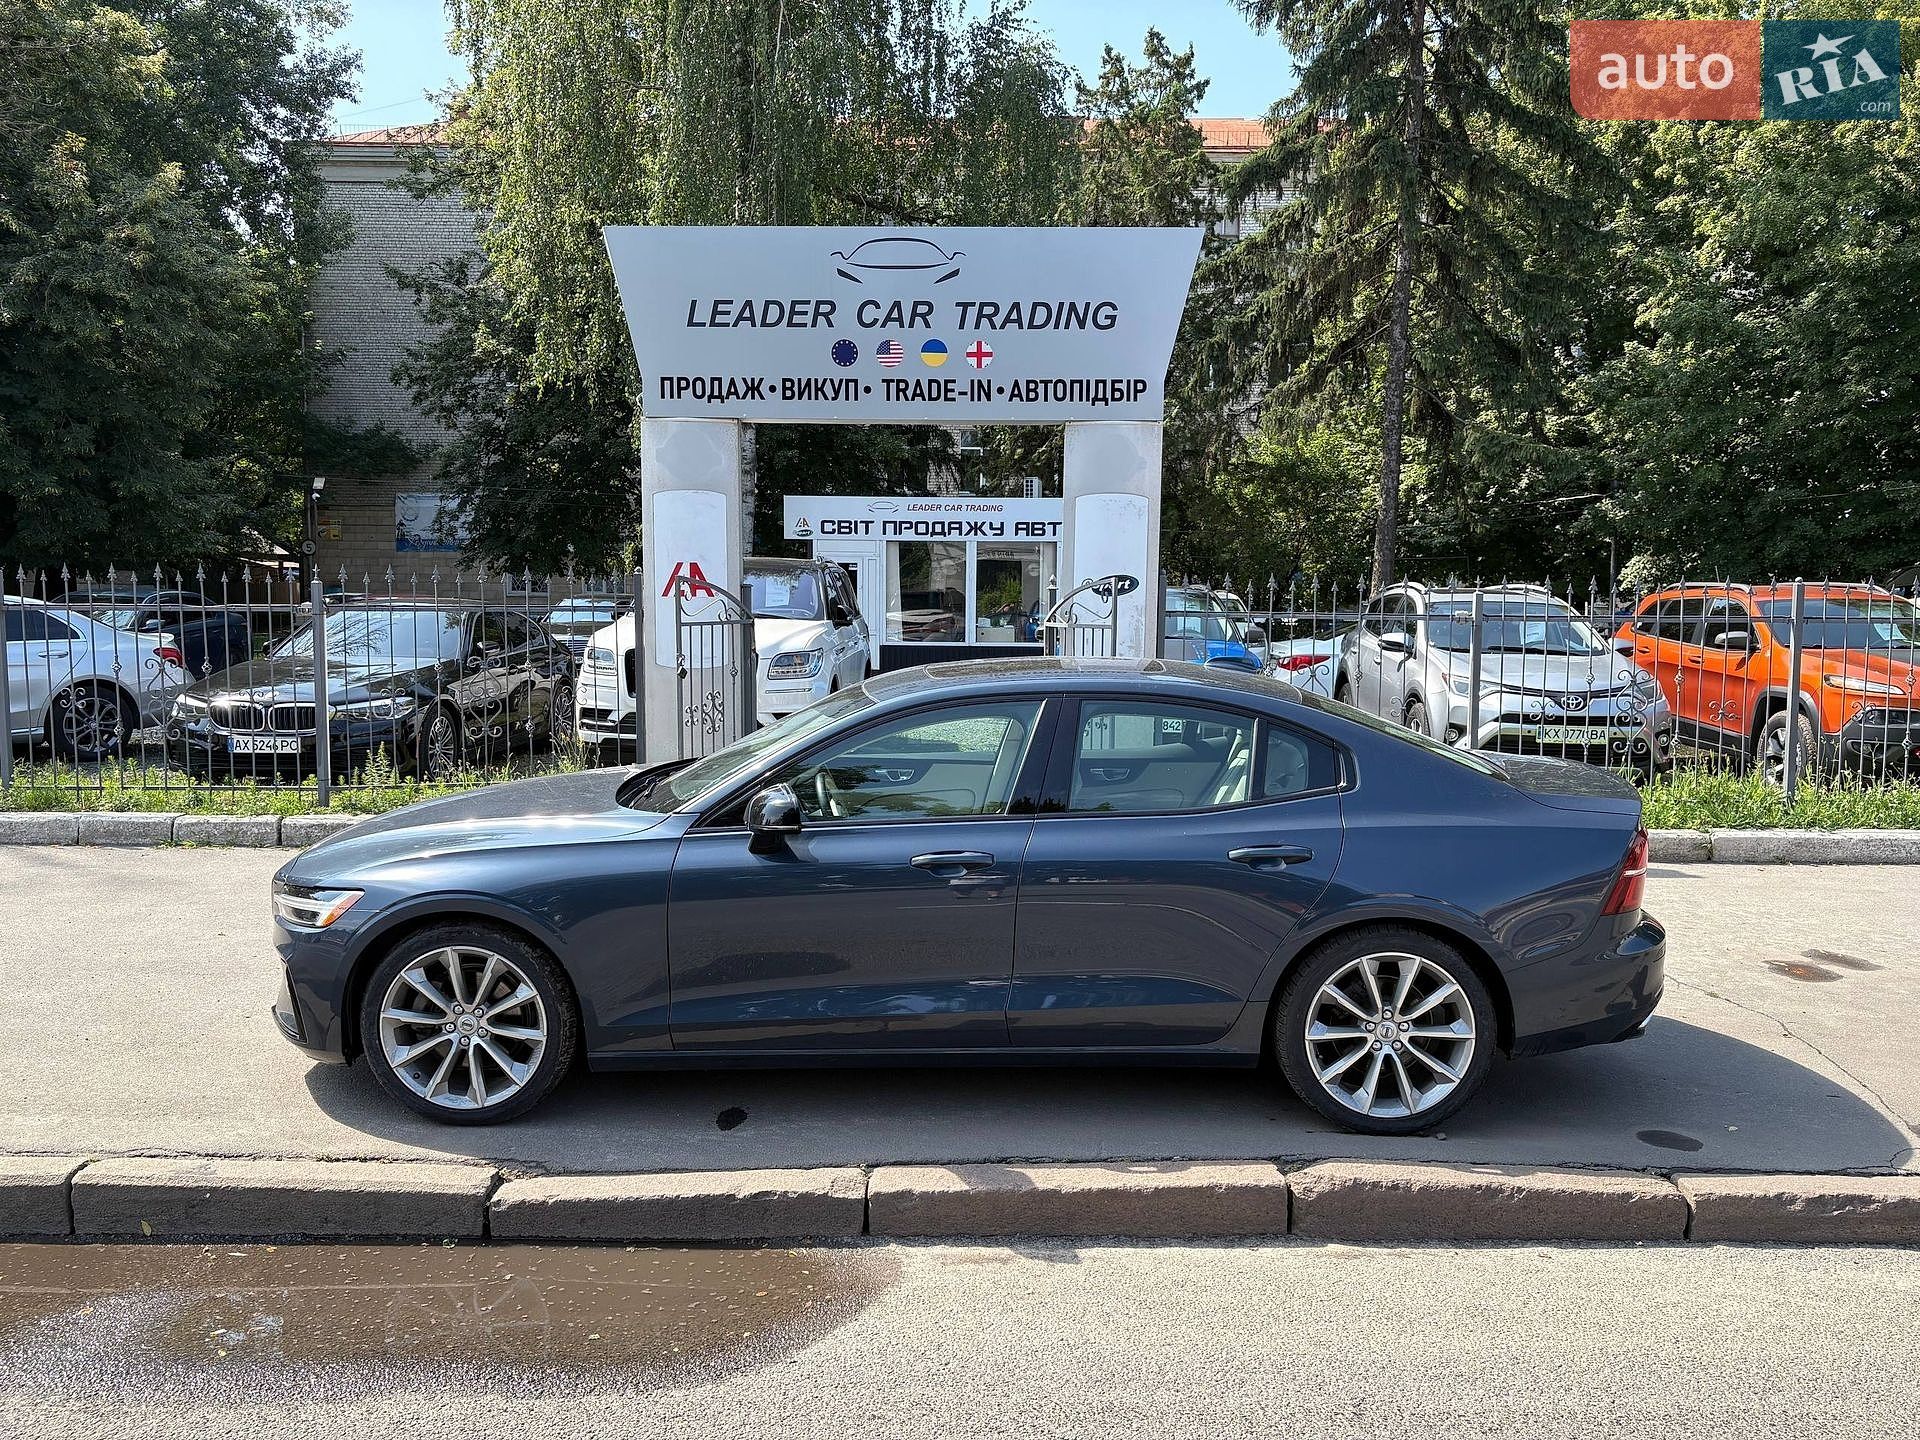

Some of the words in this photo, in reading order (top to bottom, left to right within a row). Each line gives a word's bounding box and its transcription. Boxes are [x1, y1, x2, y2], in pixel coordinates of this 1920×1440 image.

[686, 299, 837, 329] LEADER
[856, 299, 935, 330] CAR
[954, 300, 1118, 331] TRADING
[659, 376, 766, 403] ПРОДАЖ
[781, 377, 859, 402] ВИКУП
[881, 378, 992, 402] TRADE-IN
[1007, 378, 1147, 407] АВТОПІДБІР
[907, 503, 942, 512] LEADER
[944, 504, 963, 512] CAR
[965, 504, 1004, 513] TRADING
[820, 519, 875, 535] СВІТ
[882, 520, 1005, 538] ПРОДАЖУ
[1014, 521, 1063, 537] АВТ
[1162, 720, 1181, 731] 842
[234, 739, 250, 751] AX
